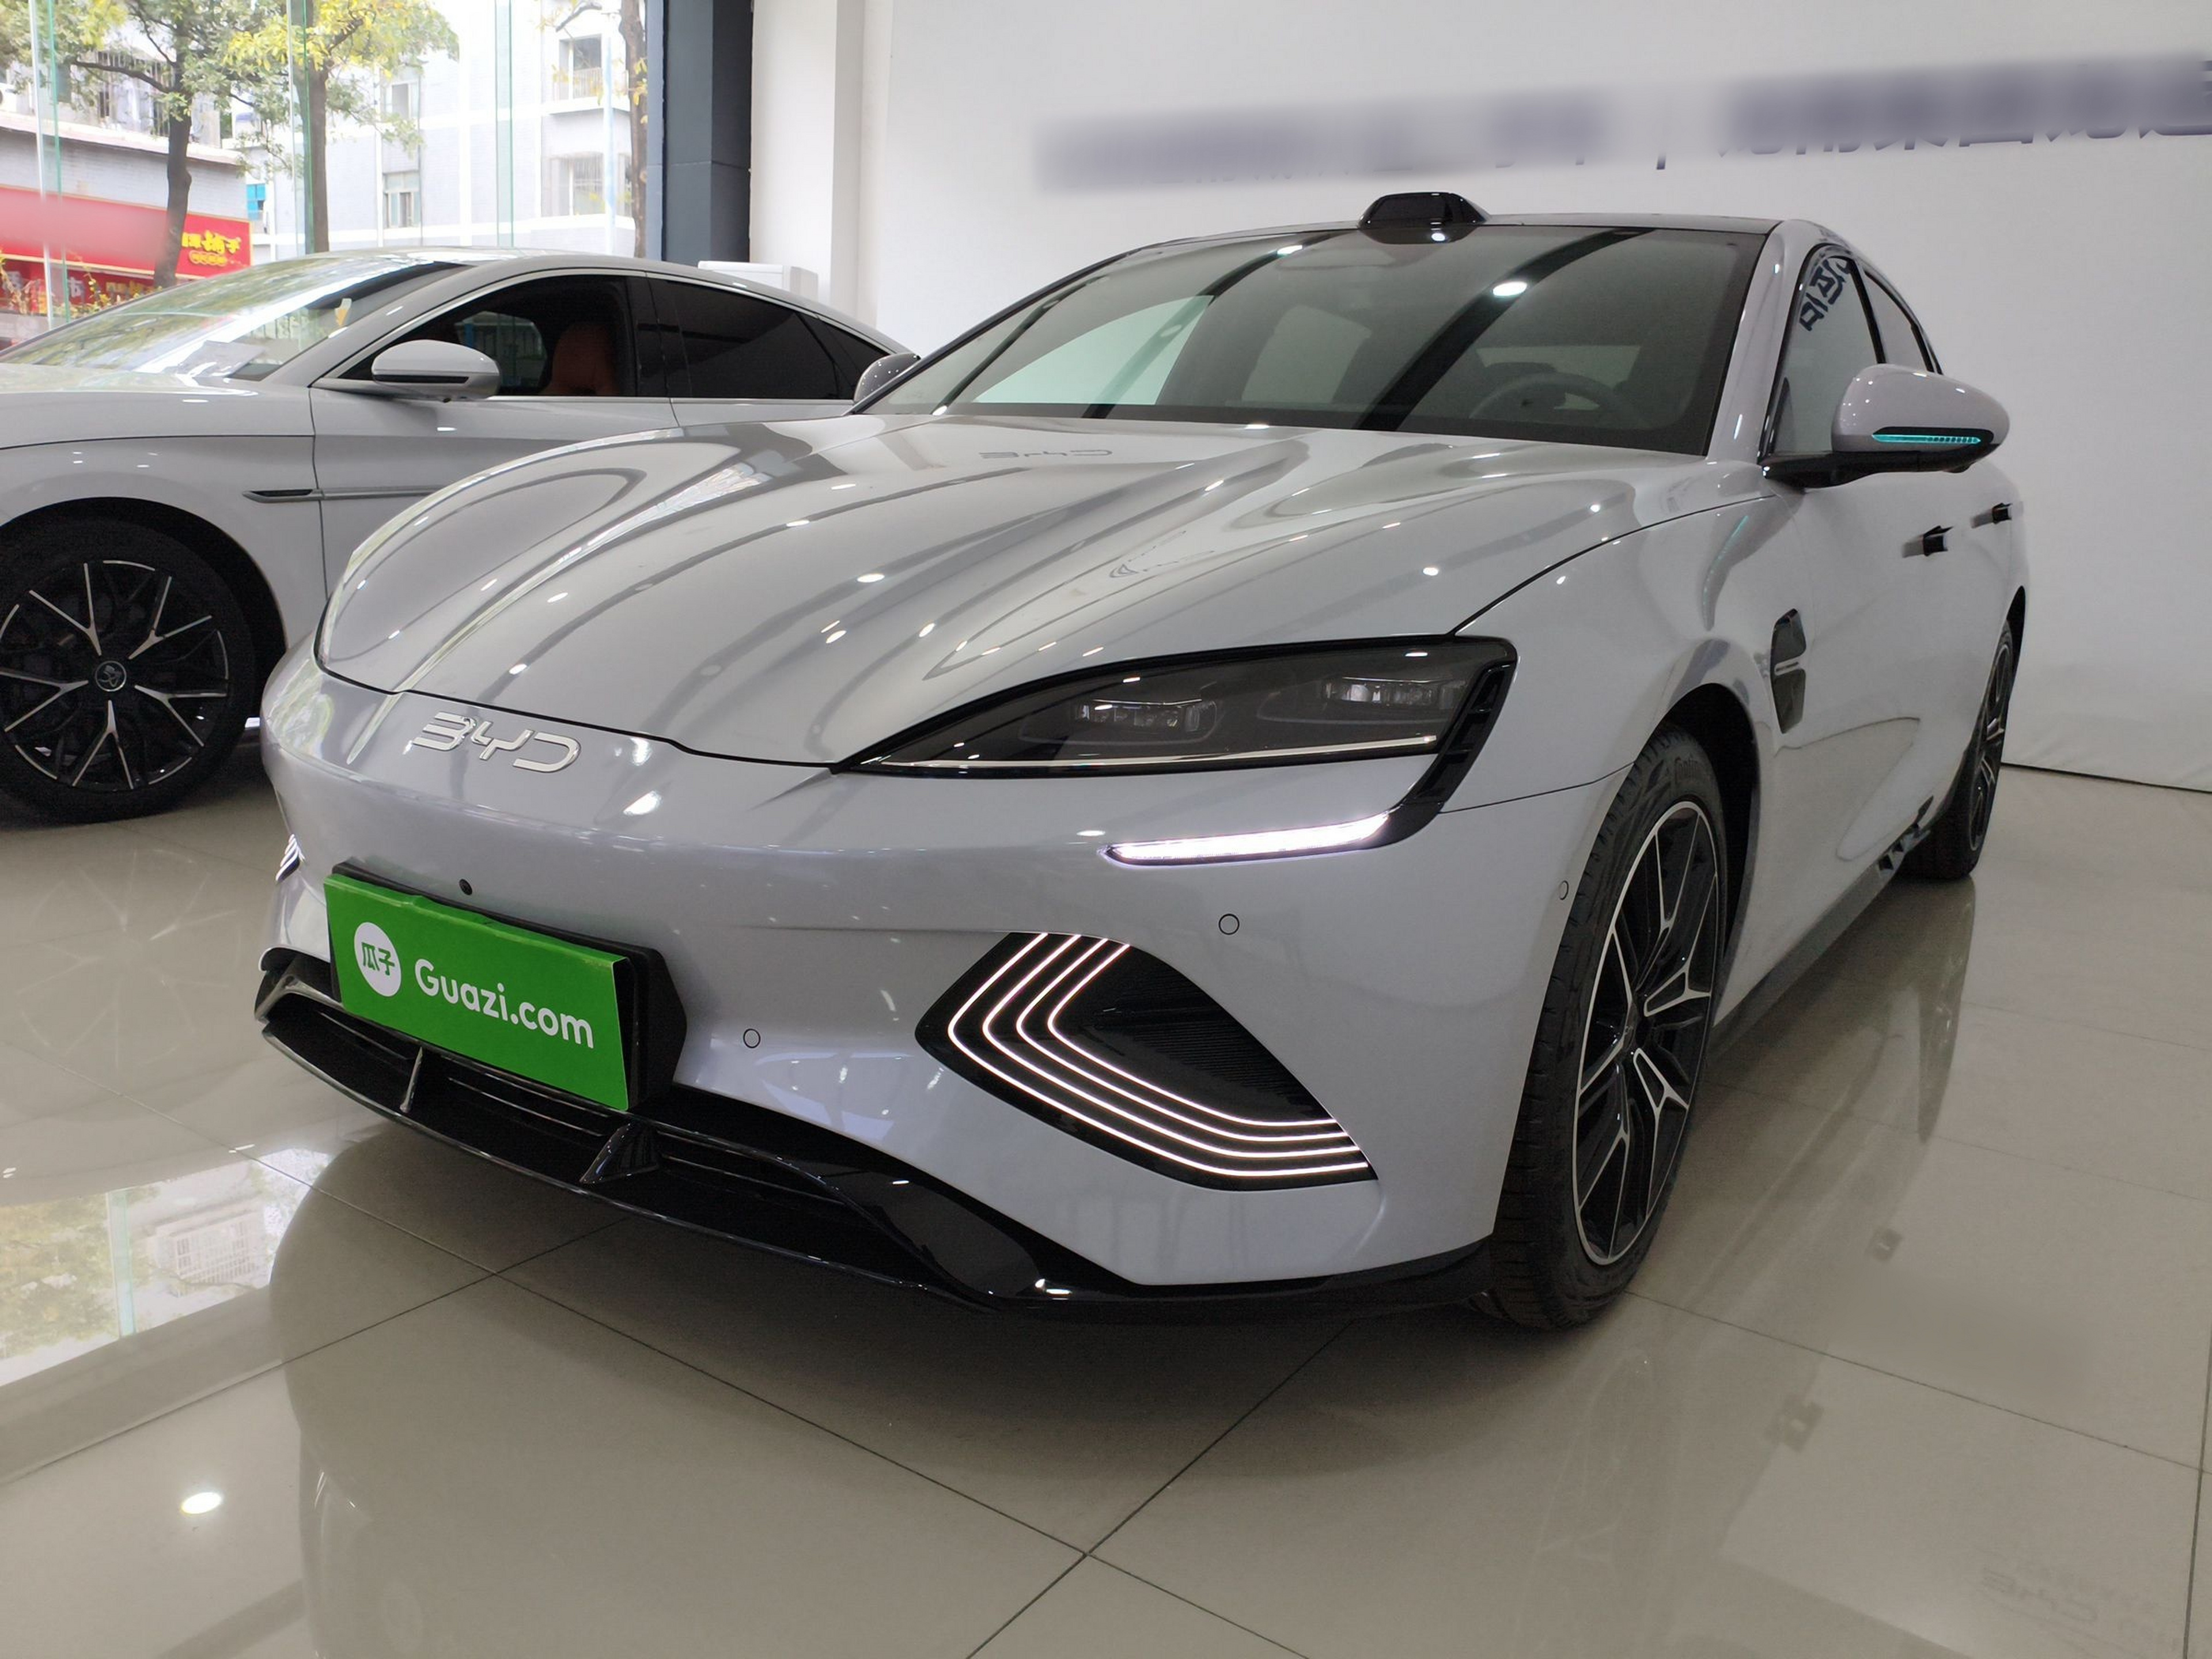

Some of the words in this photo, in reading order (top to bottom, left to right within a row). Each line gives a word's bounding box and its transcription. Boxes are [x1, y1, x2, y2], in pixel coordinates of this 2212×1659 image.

[412, 712, 581, 773] BYD
[361, 941, 395, 976] 瓜子
[414, 958, 594, 1049] Guazi.com
